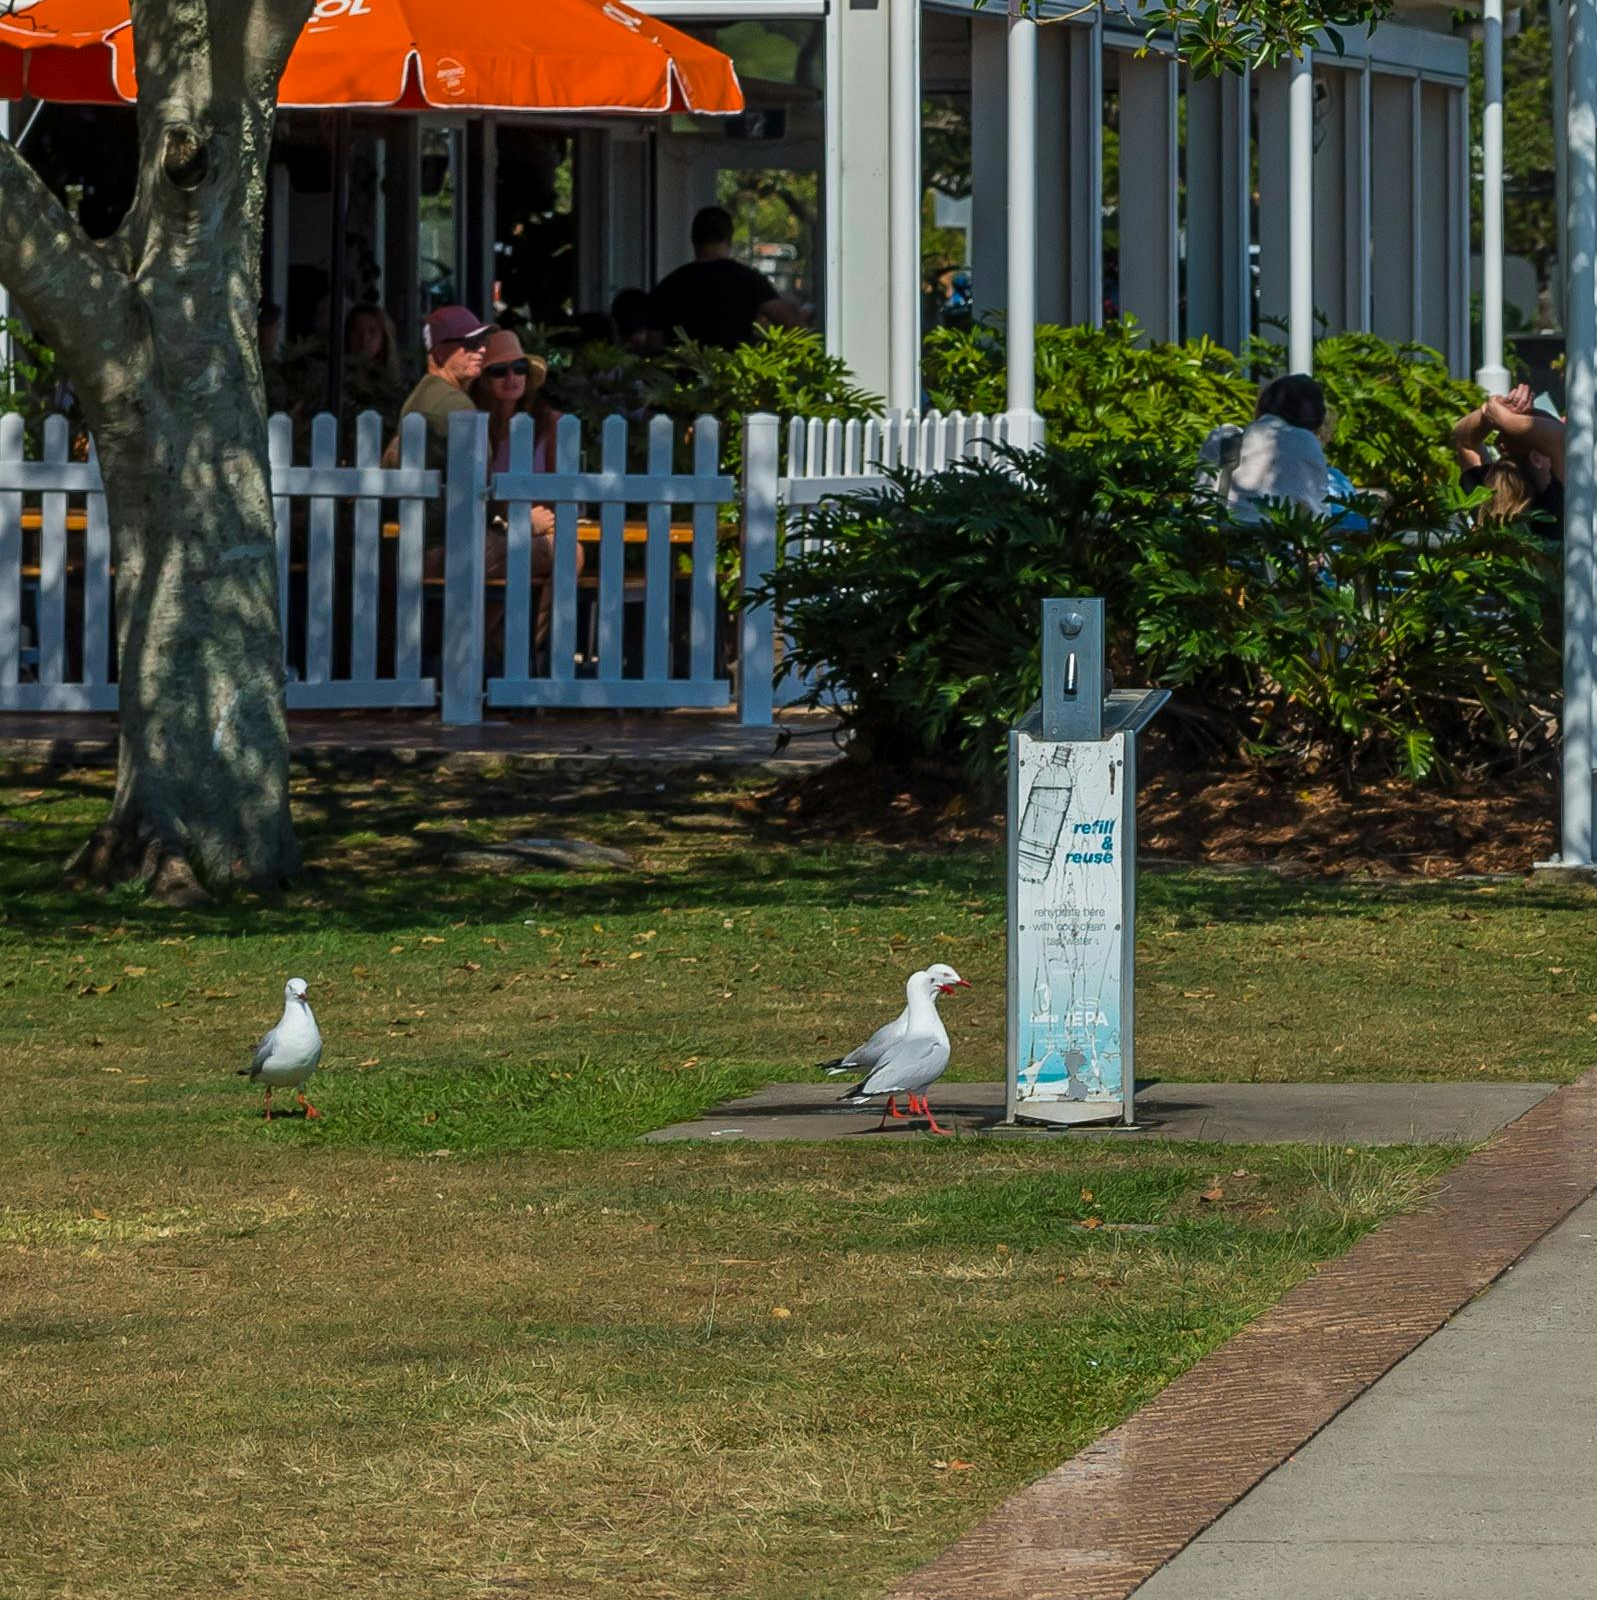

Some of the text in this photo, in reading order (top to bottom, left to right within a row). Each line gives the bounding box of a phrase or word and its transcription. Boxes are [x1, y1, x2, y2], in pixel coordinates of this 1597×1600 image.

[1073, 819, 1116, 834] refill
[1101, 835, 1113, 850] &
[1065, 852, 1113, 864] reuse
[1083, 906, 1105, 917] here
[1032, 922, 1053, 932] with
